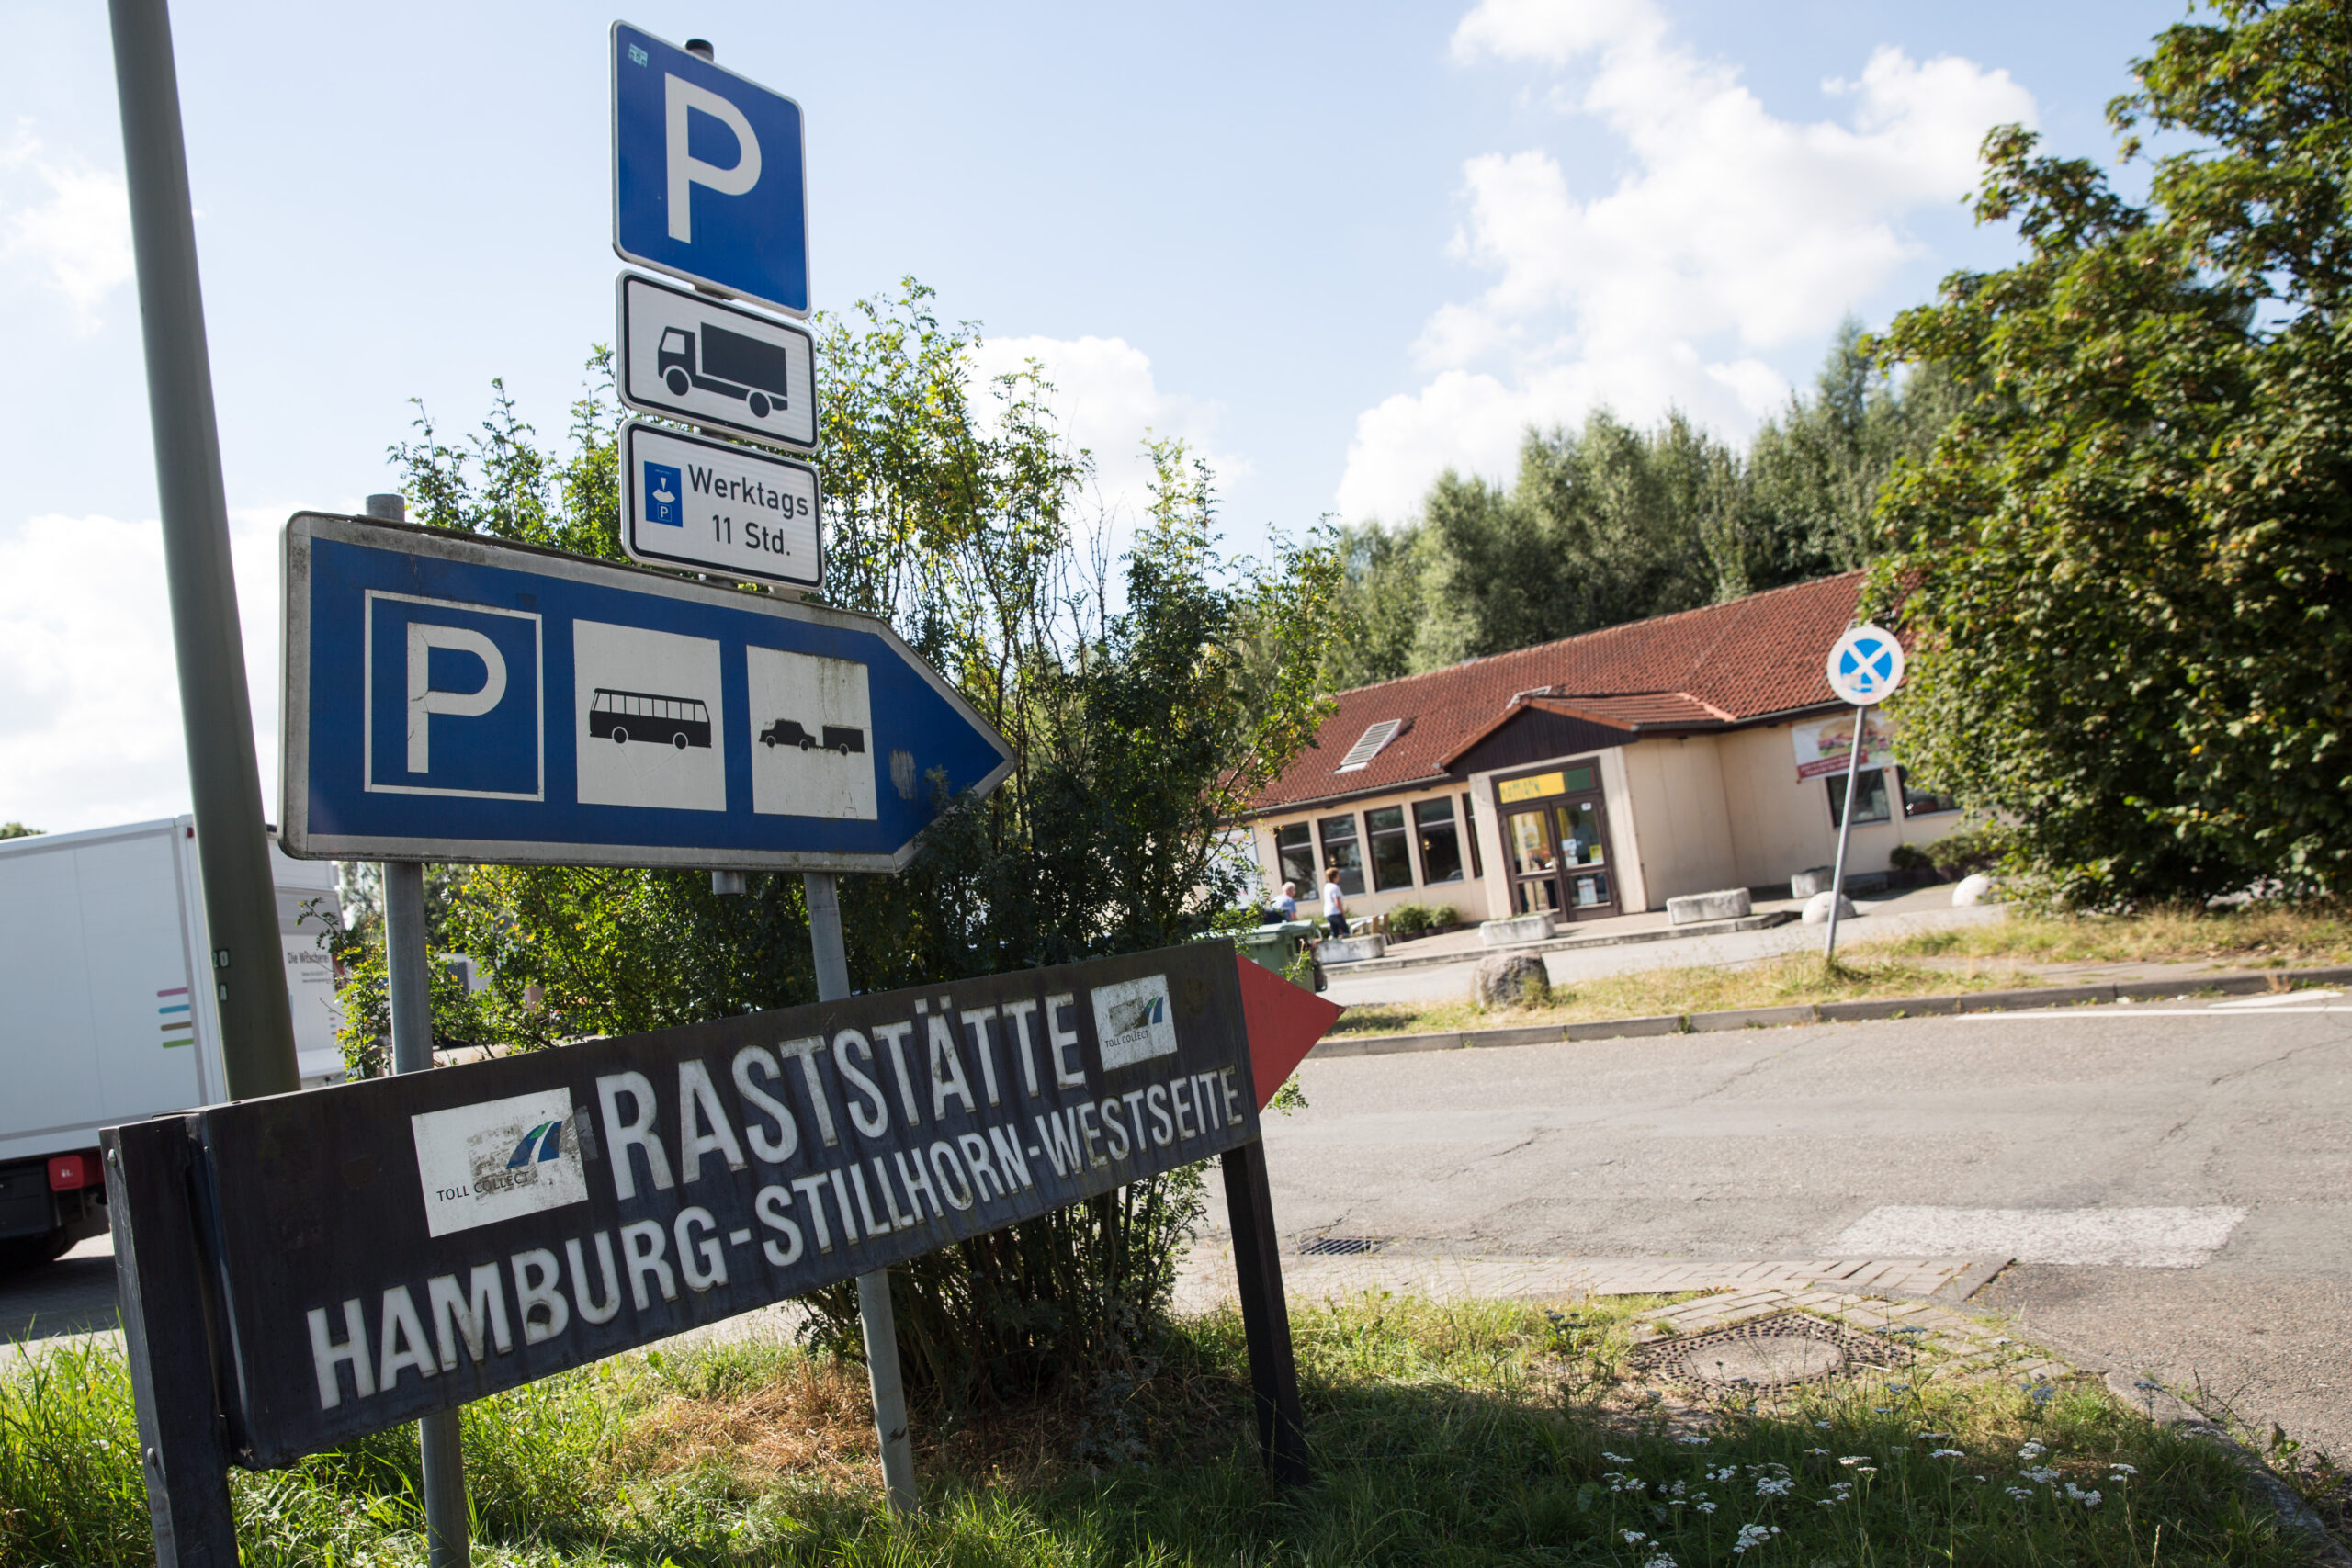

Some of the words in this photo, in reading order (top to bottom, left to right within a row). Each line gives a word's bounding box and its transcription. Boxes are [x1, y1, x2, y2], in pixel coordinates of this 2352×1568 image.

[665, 72, 762, 244] P
[661, 506, 669, 518] P
[688, 464, 808, 520] Werktags
[712, 514, 731, 544] 11
[745, 522, 790, 556] Std.
[407, 622, 507, 773] P
[1105, 1037, 1121, 1048] TOLL
[1122, 1030, 1149, 1043] COLLECT
[596, 992, 1087, 1201] RASTSTÄTTE
[436, 1186, 469, 1201] TOLL
[474, 1171, 529, 1193] COLLECT
[307, 1065, 1244, 1410] HAMBURG-STILLHORN-WESTSEITE
